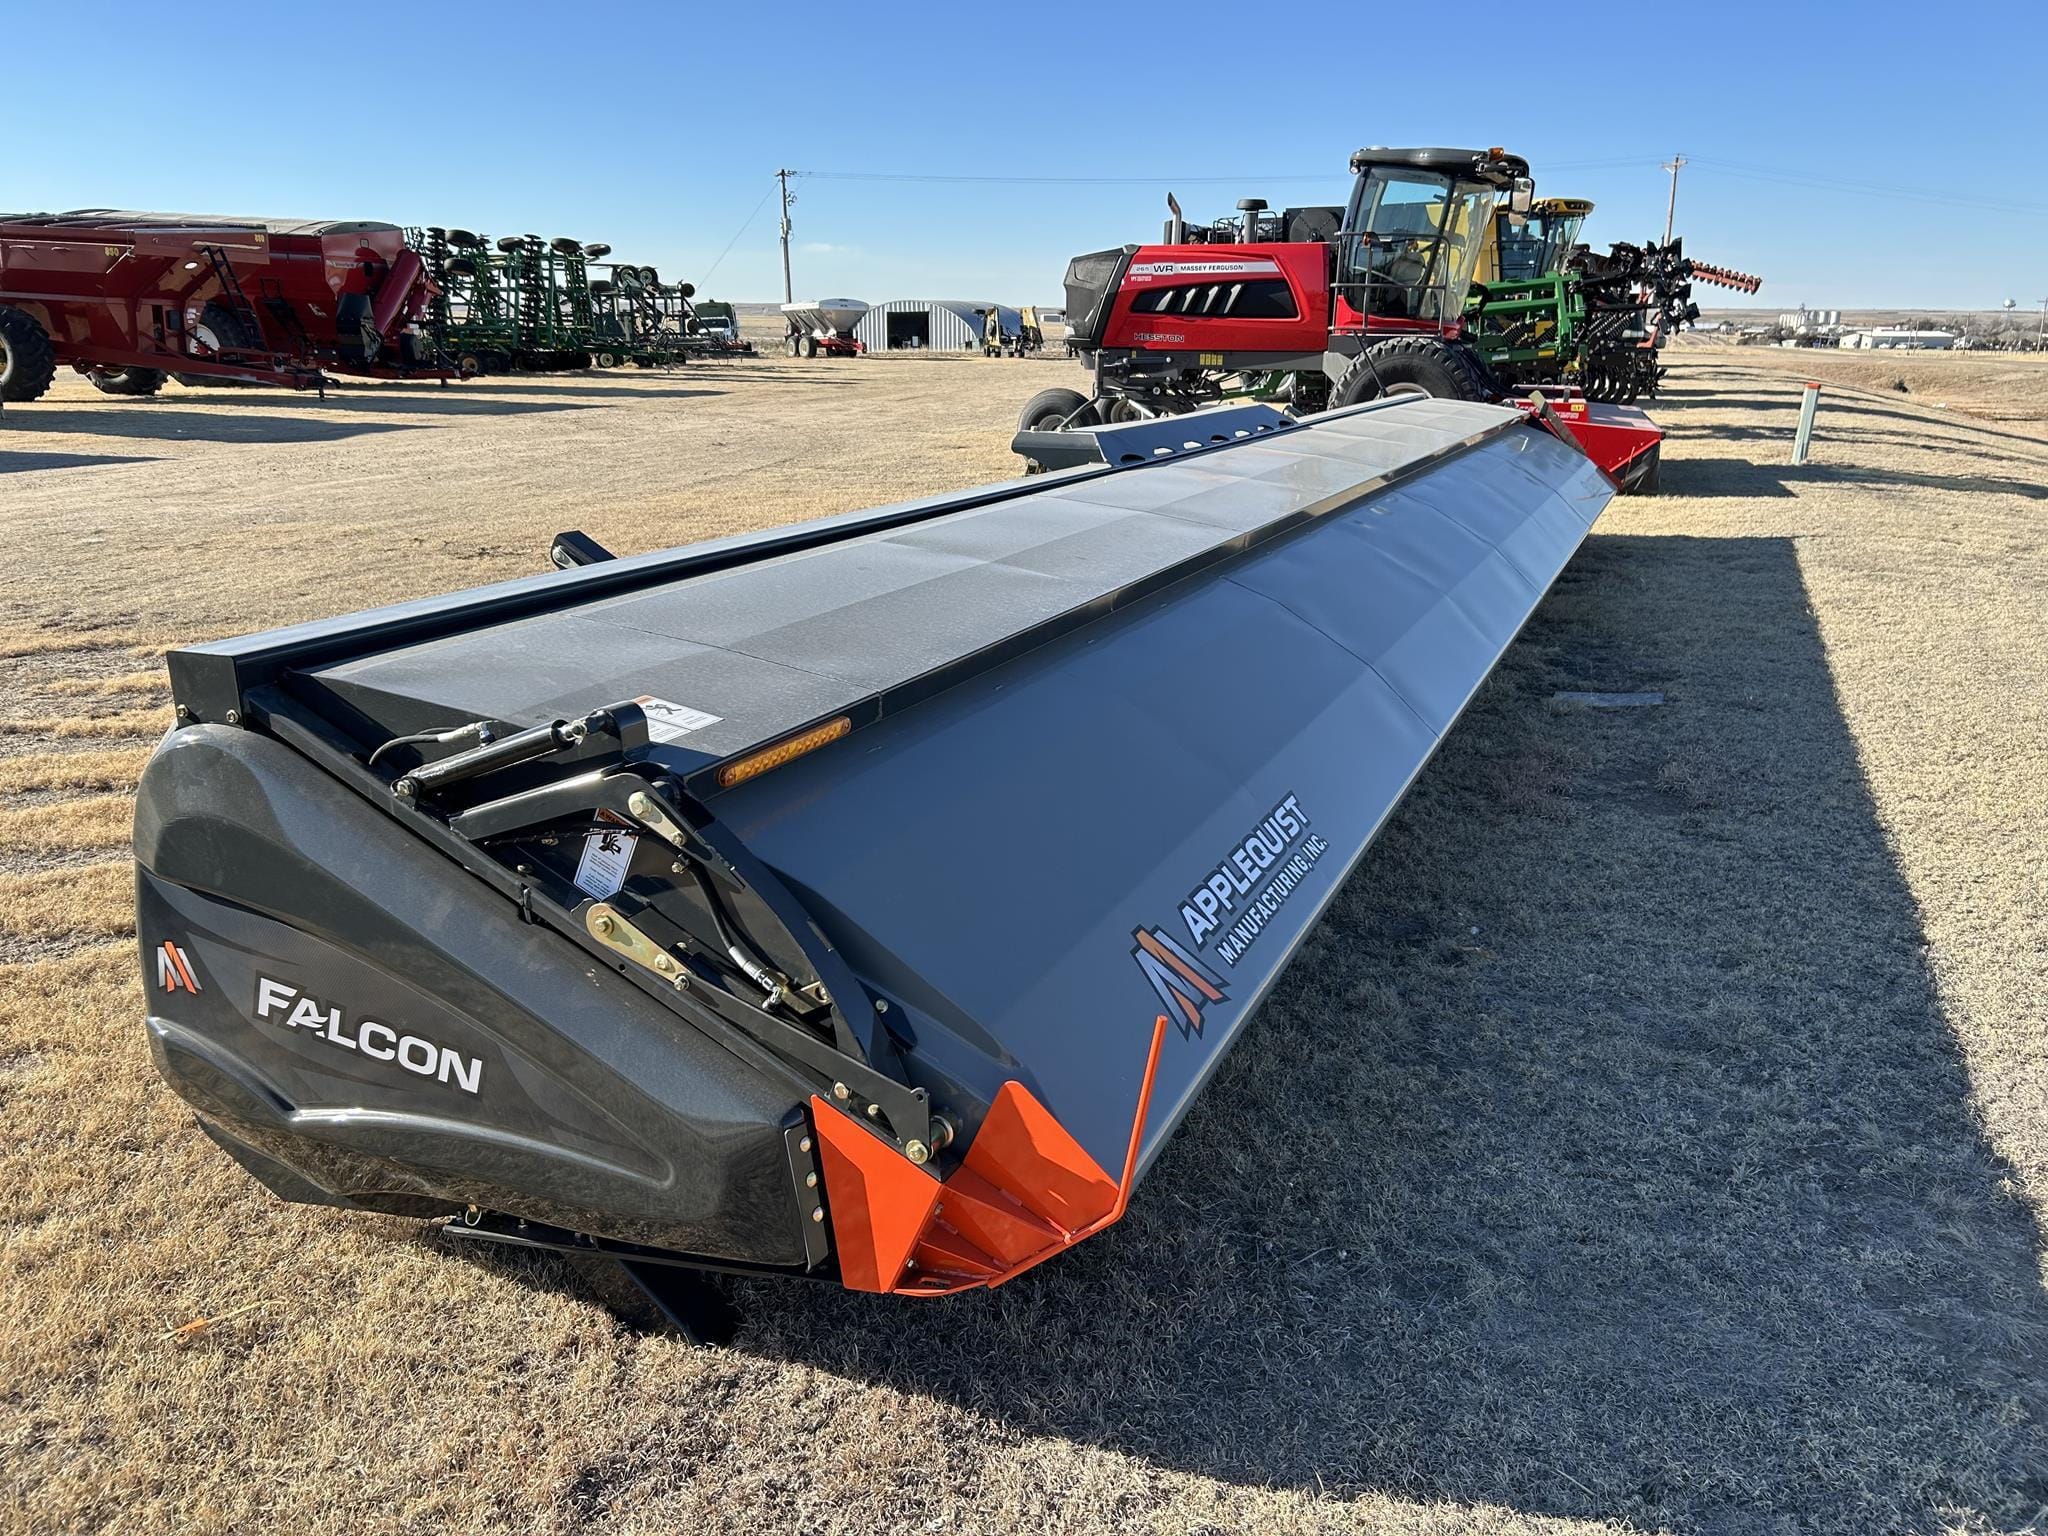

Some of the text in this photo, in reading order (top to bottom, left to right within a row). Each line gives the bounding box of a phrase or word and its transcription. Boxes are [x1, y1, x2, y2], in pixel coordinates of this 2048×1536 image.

[1152, 264, 1174, 273] WR
[1134, 332, 1185, 343] HESSTON
[1302, 833, 1329, 863] INC.
[1181, 794, 1309, 945] APPLEQUIST
[257, 977, 483, 1094] FALCON
